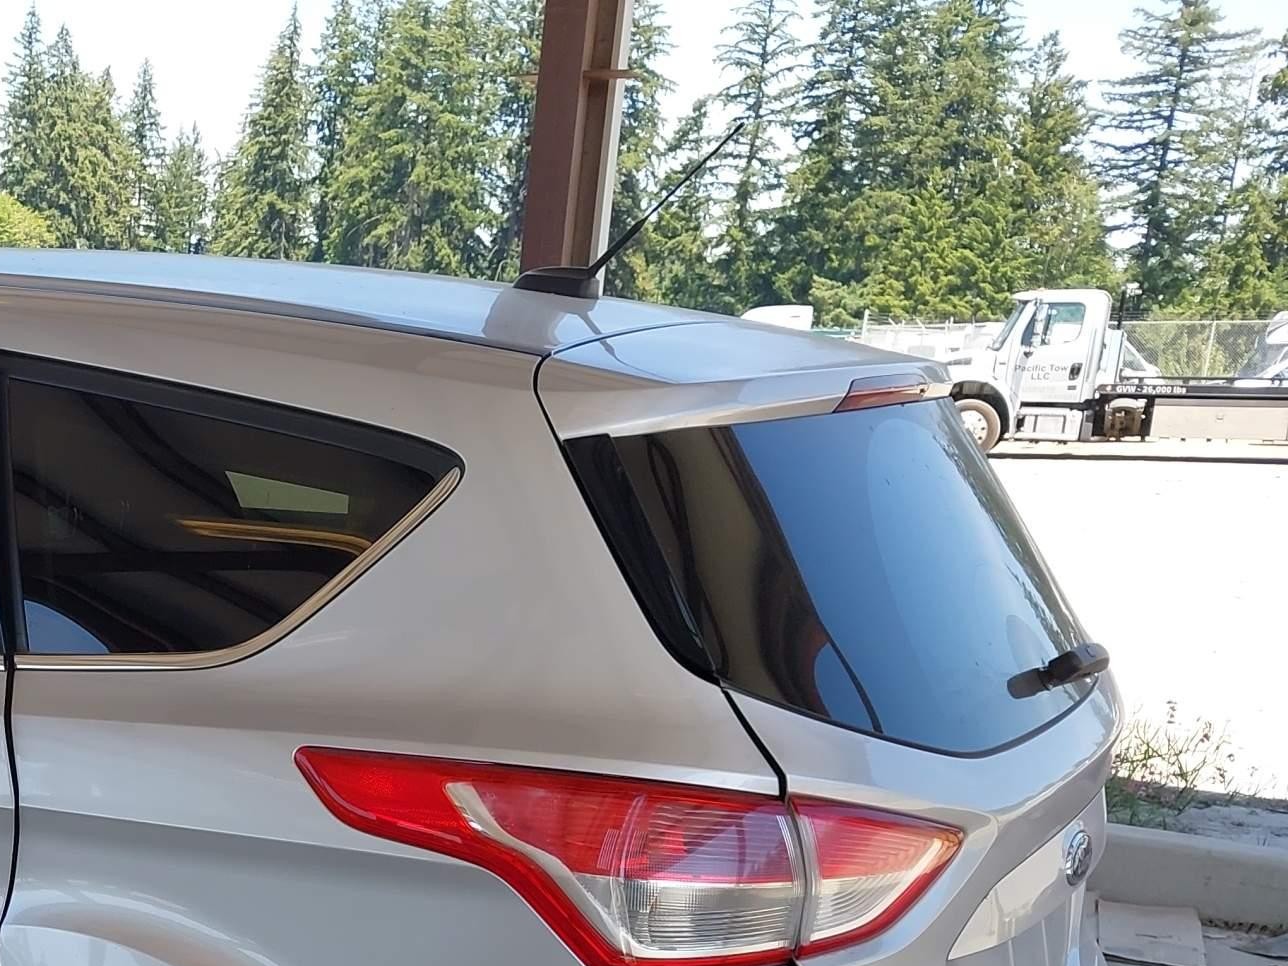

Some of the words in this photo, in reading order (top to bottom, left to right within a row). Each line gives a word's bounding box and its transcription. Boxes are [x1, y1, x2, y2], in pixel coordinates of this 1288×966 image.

[1015, 363, 1047, 372] Pacific
[1050, 364, 1069, 372] Tow
[1031, 372, 1050, 380] LLC
[1116, 385, 1137, 393] GVW
[1142, 385, 1172, 395] 26,000
[1173, 385, 1187, 394] lbs
